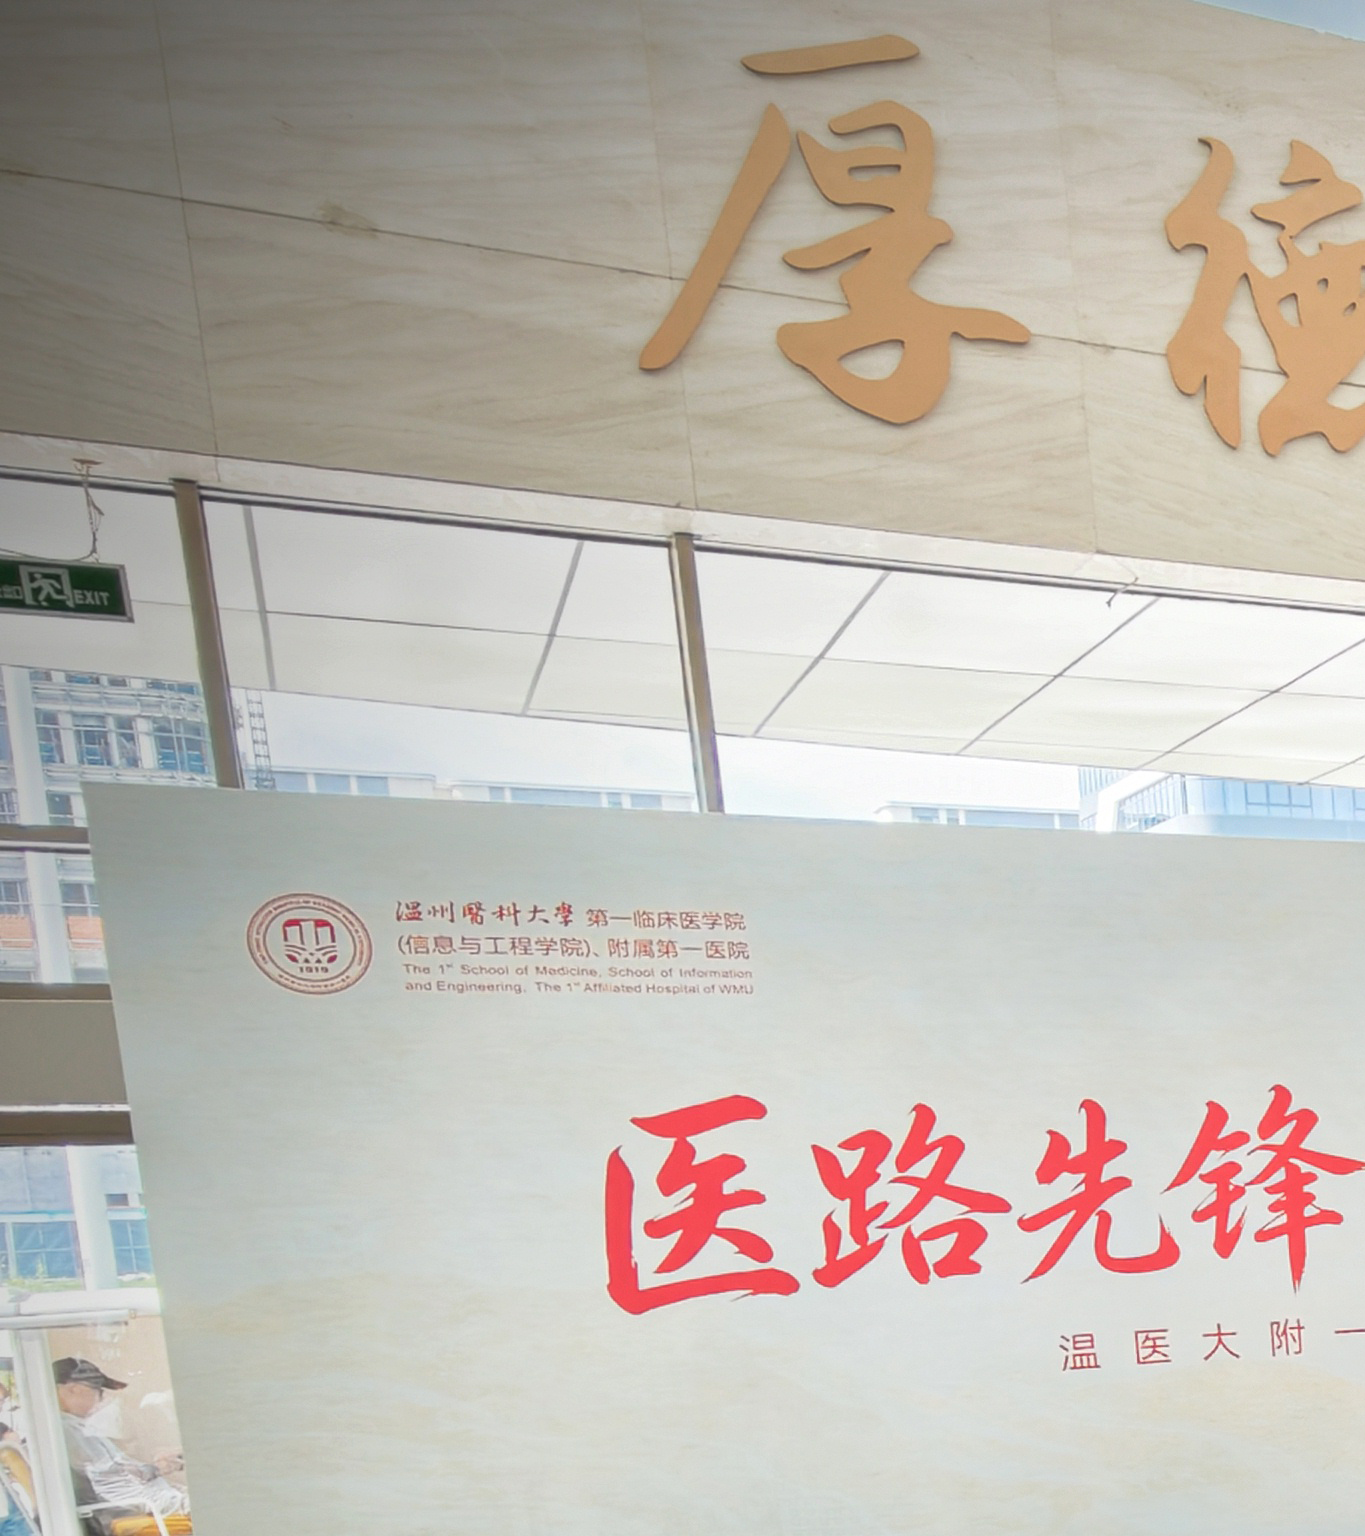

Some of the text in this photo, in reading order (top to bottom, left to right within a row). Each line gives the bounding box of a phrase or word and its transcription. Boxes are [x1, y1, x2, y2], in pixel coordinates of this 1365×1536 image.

[73, 589, 109, 606] EXIT
[585, 908, 747, 930] 第一临床医学院
[460, 964, 509, 976] School
[515, 964, 528, 976] of
[608, 967, 655, 978] School
[660, 968, 673, 979] of
[679, 968, 753, 980] Information
[583, 983, 642, 995] Affiliated
[646, 985, 700, 996] Hospital
